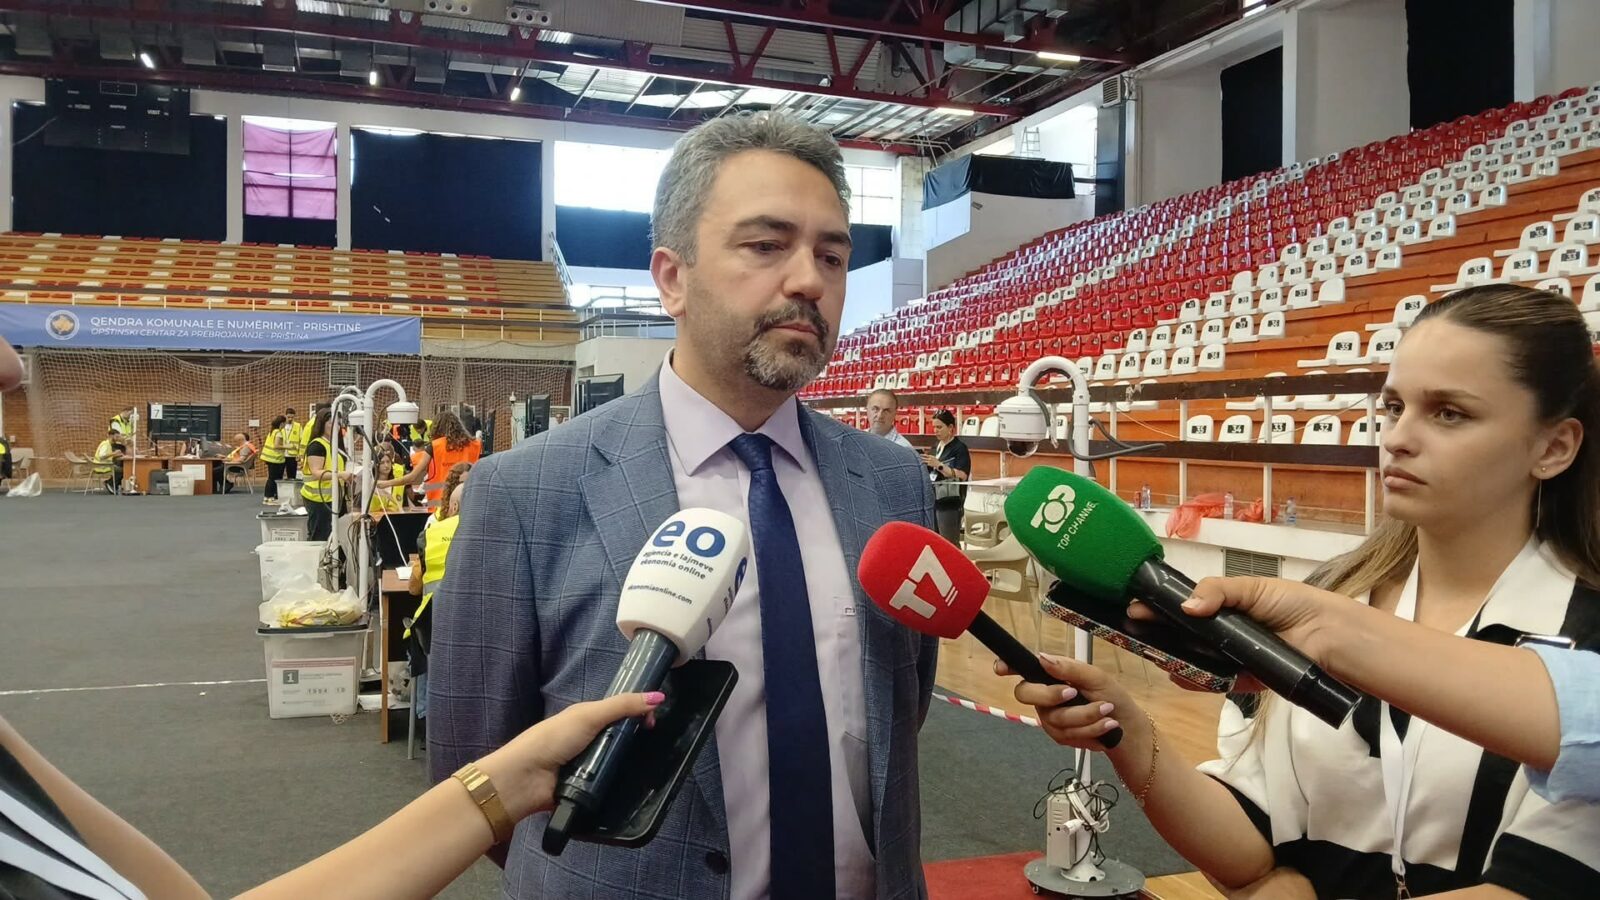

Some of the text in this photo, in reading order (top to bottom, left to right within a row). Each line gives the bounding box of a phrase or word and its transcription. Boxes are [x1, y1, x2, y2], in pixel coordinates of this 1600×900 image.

[90, 316, 144, 327] QENDRA
[146, 318, 214, 328] KOMUNALE
[217, 319, 225, 328] E
[227, 319, 294, 331] NUMËRIMIT
[140, 328, 175, 337] CENTAR
[178, 329, 189, 337] ZA
[190, 329, 265, 339] PREBROJAVANJE
[271, 331, 309, 340] PRIŠTINA
[153, 408, 160, 418] 7
[1030, 484, 1076, 533] TOP
[652, 520, 726, 558] eo
[1057, 533, 1071, 550] TOP
[640, 558, 706, 580] ekonomia online
[680, 553, 714, 573] lajmeve
[888, 544, 954, 620] T7
